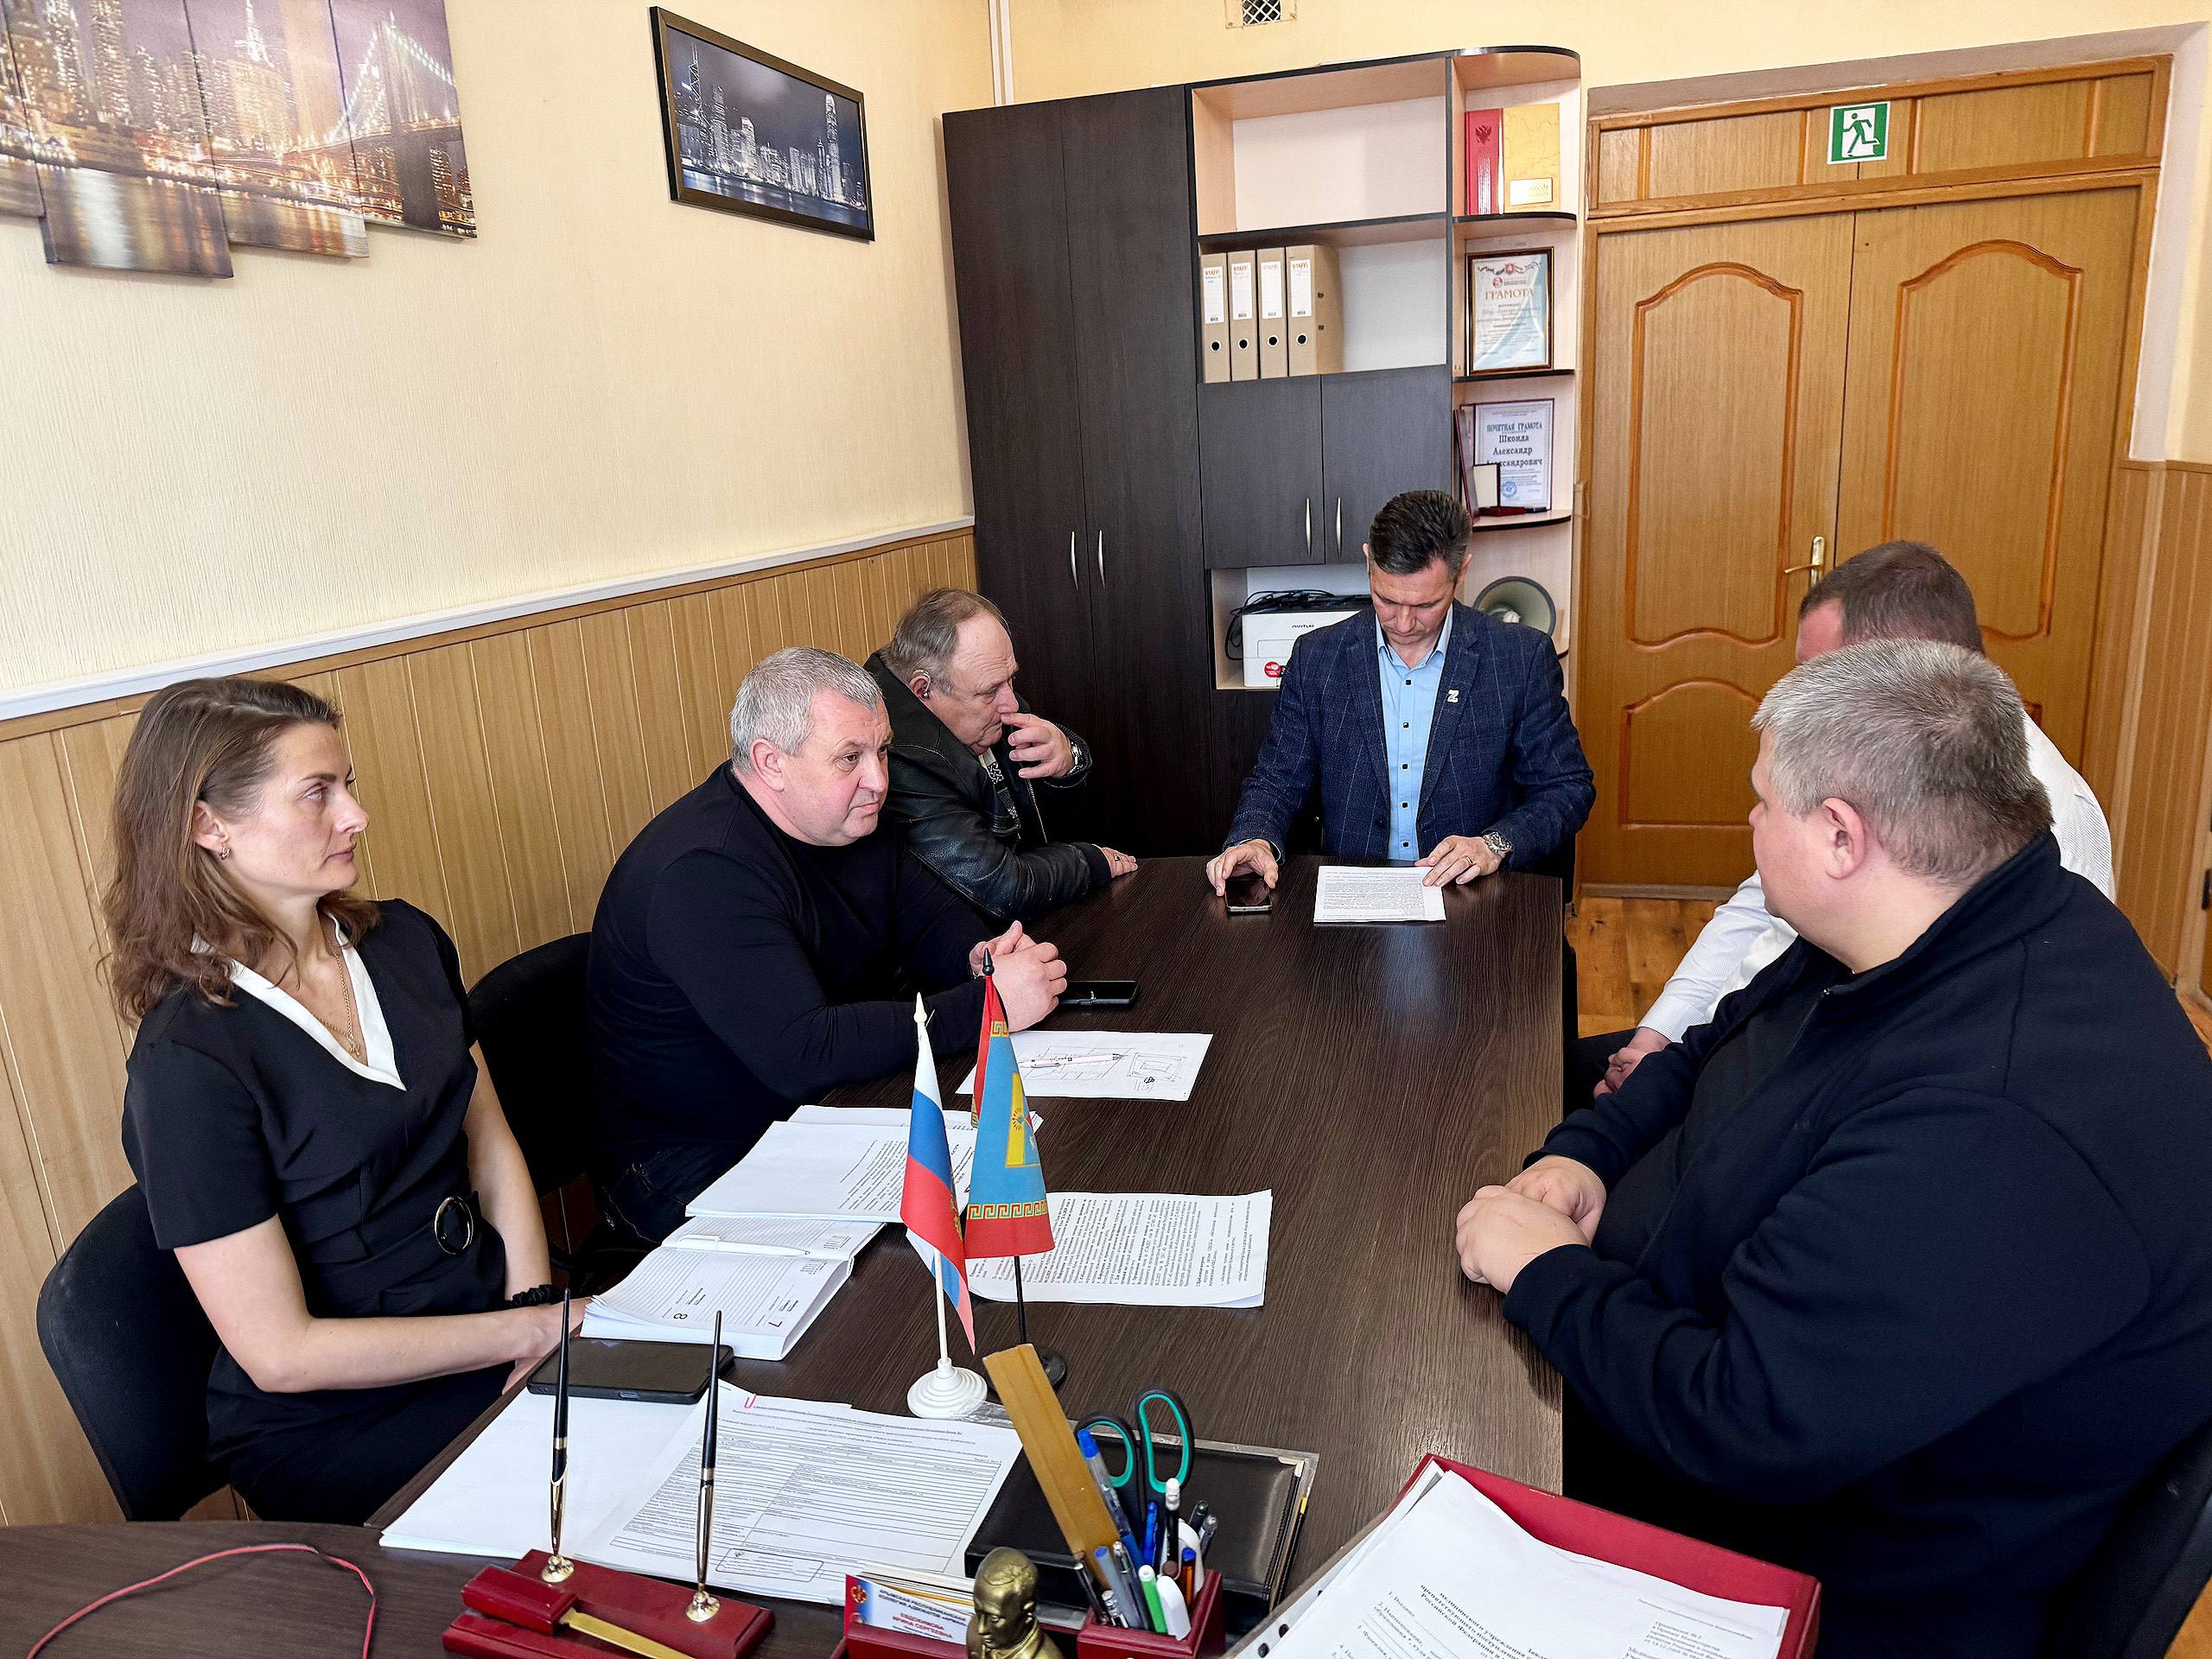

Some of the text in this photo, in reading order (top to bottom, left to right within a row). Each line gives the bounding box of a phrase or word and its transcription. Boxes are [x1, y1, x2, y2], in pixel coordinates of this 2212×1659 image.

[1485, 288, 1535, 300] ГРАМОТА
[1517, 422, 1542, 430] ГРАМОТА
[1499, 435, 1529, 443] Шконда
[1493, 447, 1533, 456] Александр
